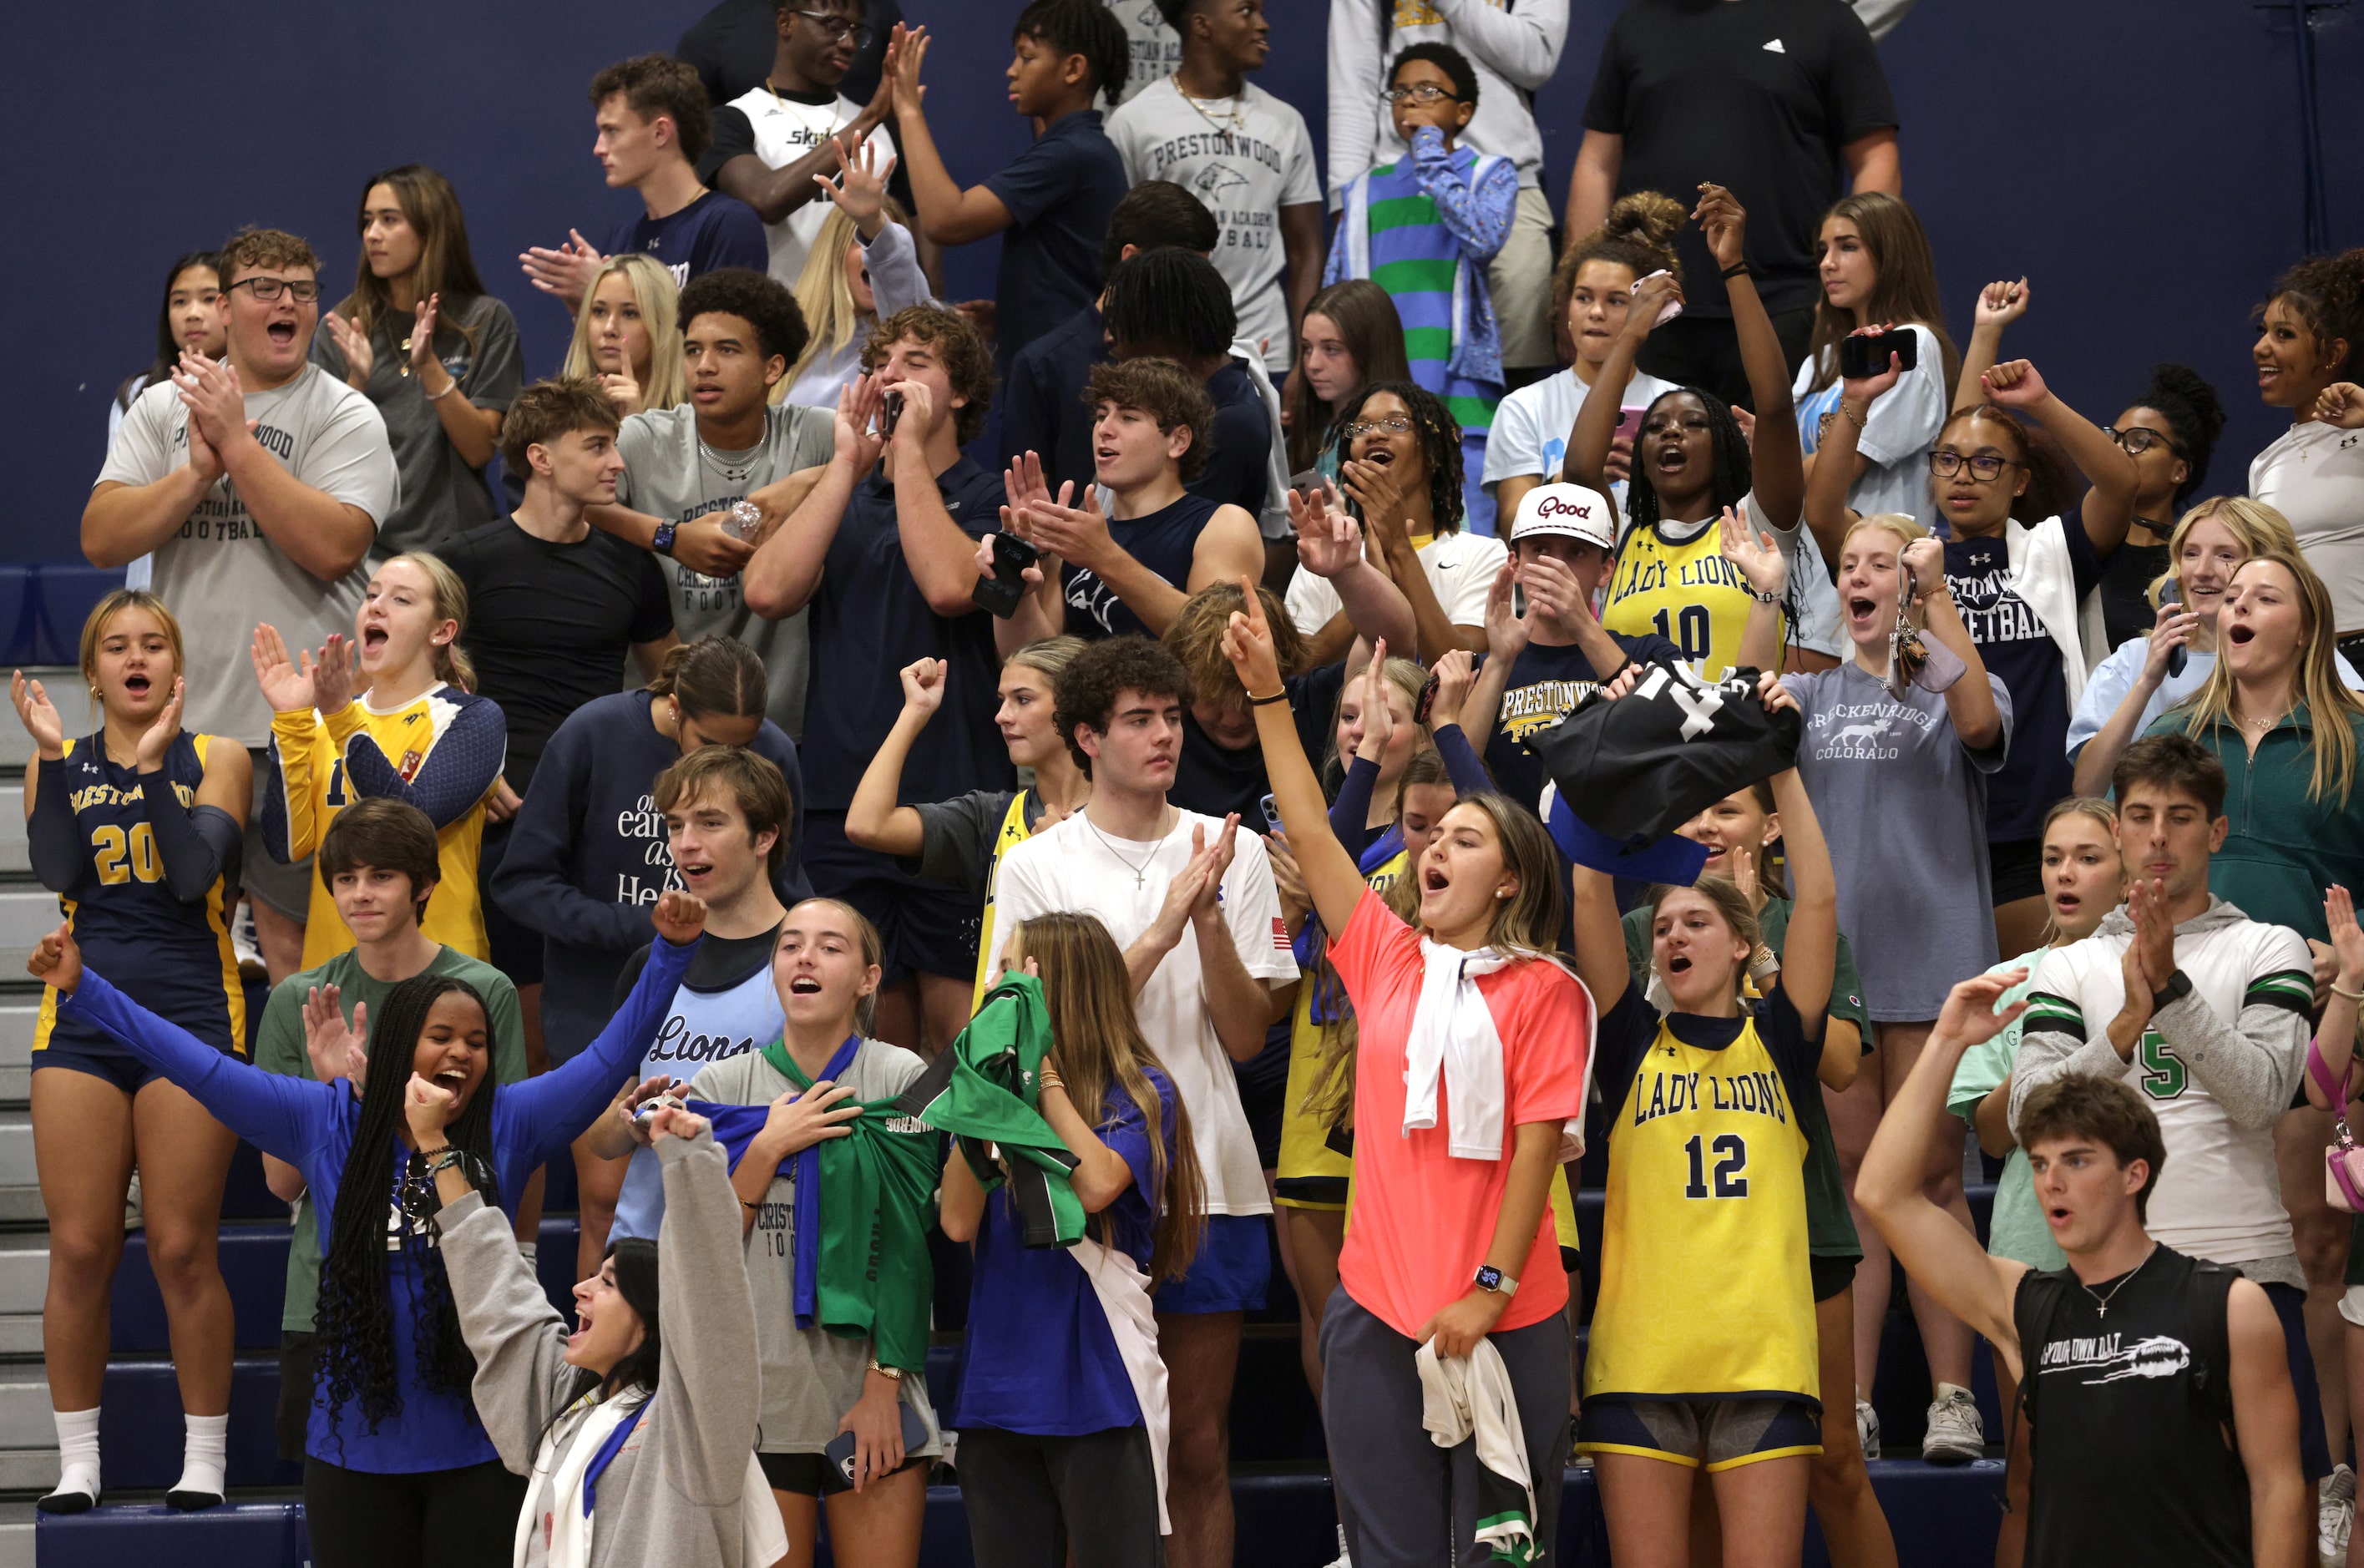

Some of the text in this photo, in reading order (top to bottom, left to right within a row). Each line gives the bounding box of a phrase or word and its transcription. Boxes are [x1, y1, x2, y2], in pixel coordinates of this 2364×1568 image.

[1154, 132, 1281, 174] PRESTONWOOD
[1537, 496, 1591, 519] Good
[1613, 560, 1668, 605] LADY
[1652, 604, 1711, 663] 10
[1815, 746, 1899, 761] COLORADO
[617, 810, 667, 838] ear
[91, 822, 165, 886] 20
[649, 1014, 753, 1063] Lions
[2139, 1029, 2189, 1100] 5
[1634, 1070, 1785, 1127] LADY LIONS
[1684, 1134, 1748, 1199] 12
[2071, 1338, 2097, 1363] OWN
